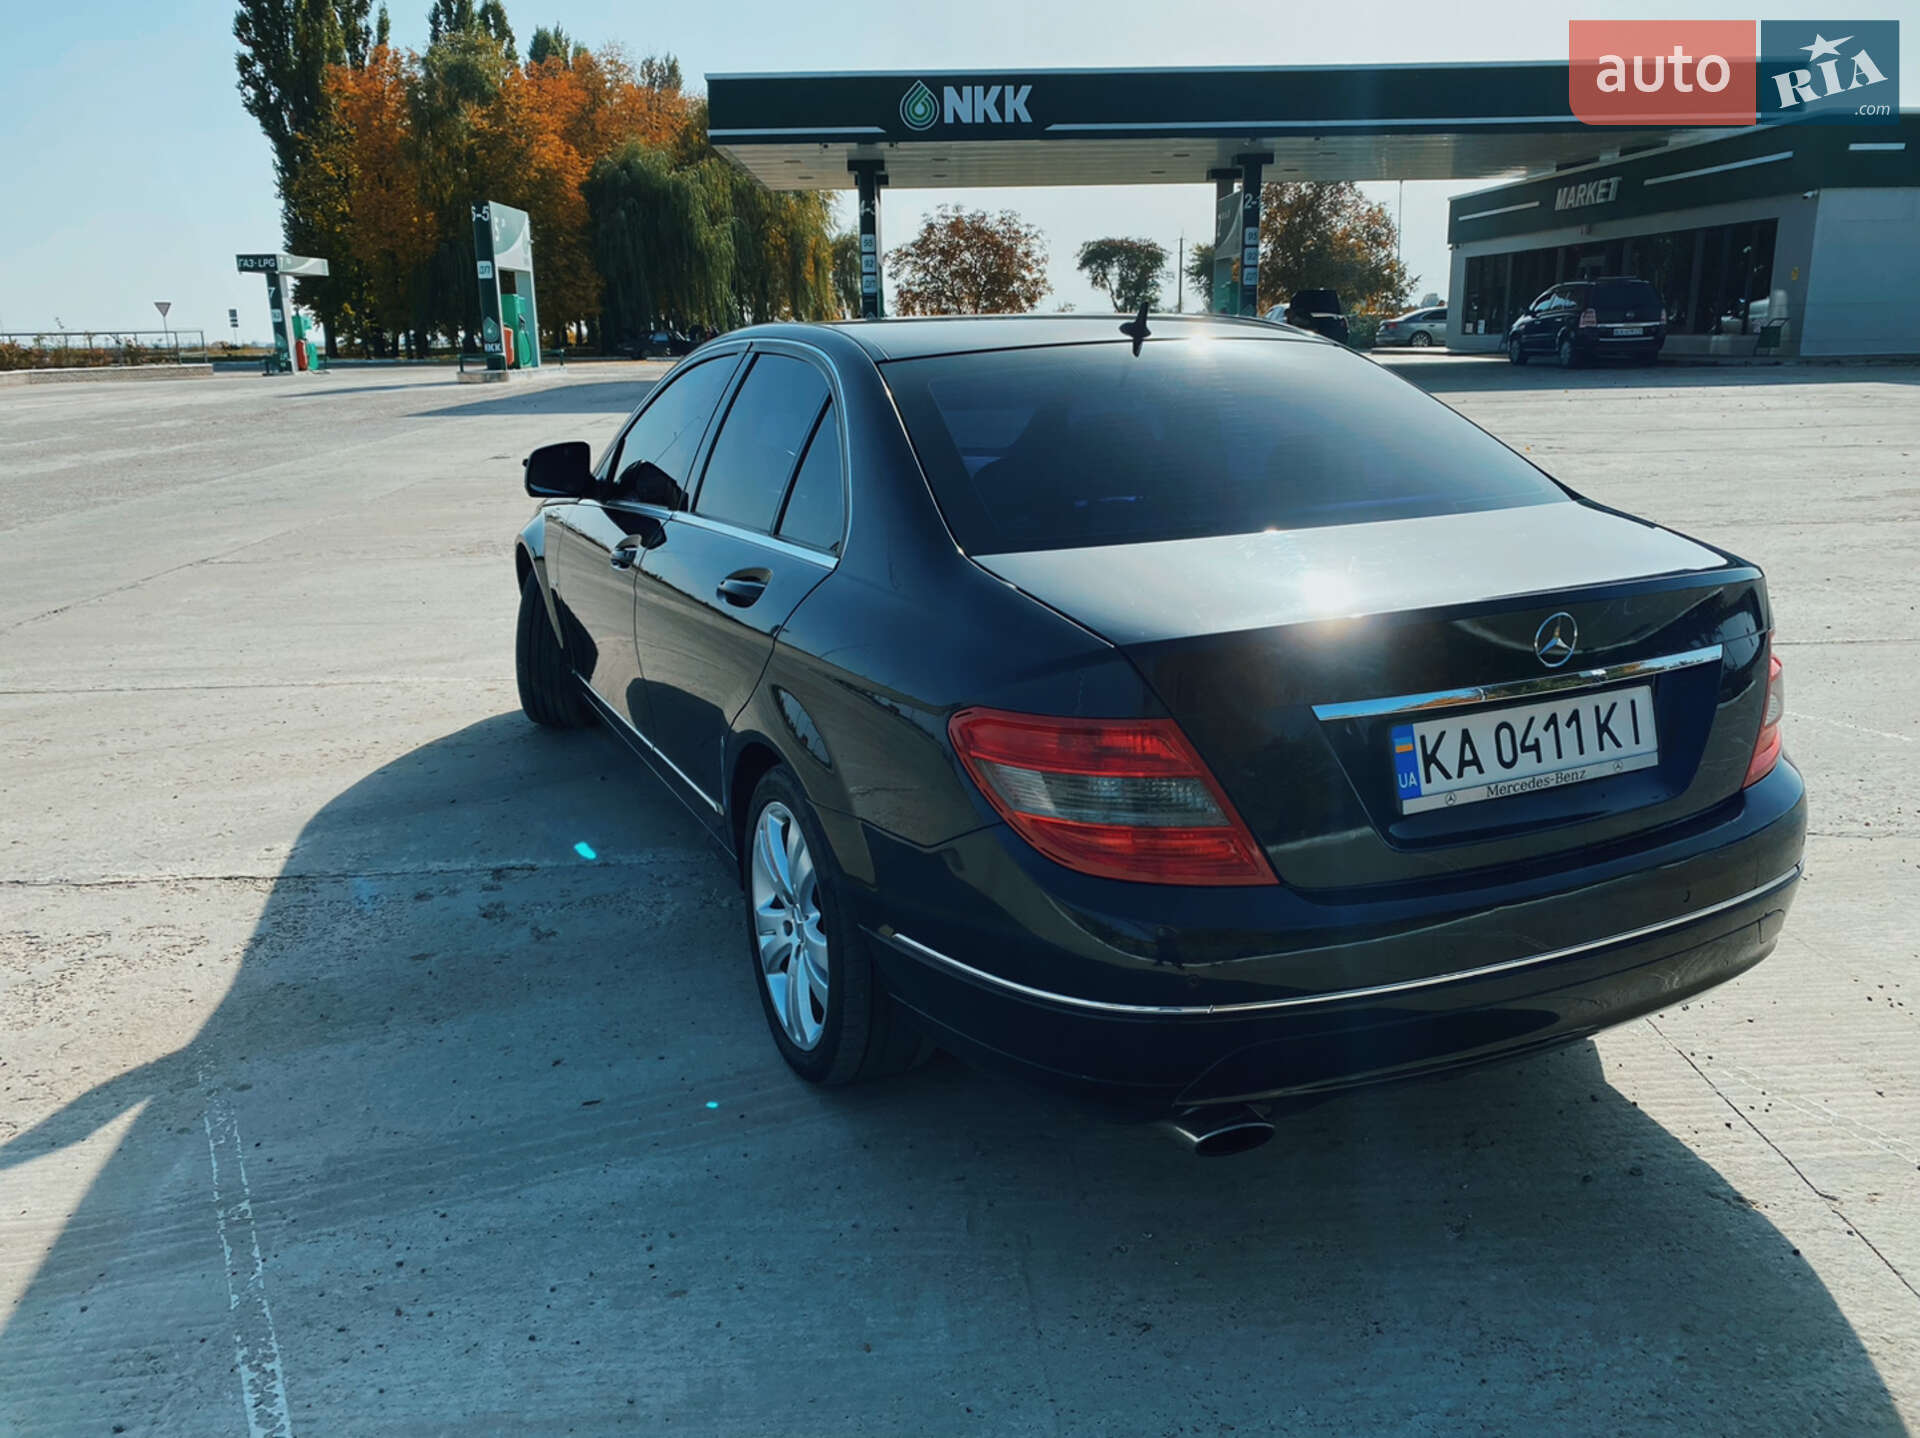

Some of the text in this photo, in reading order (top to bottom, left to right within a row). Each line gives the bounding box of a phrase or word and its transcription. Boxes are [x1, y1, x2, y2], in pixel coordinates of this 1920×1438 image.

[943, 85, 1033, 124] NKK
[1554, 176, 1623, 211] MARKET
[1419, 698, 1642, 785] KA 0411 KI
[1397, 773, 1418, 789] UA
[1485, 768, 1587, 798] Mercedes-Benz
